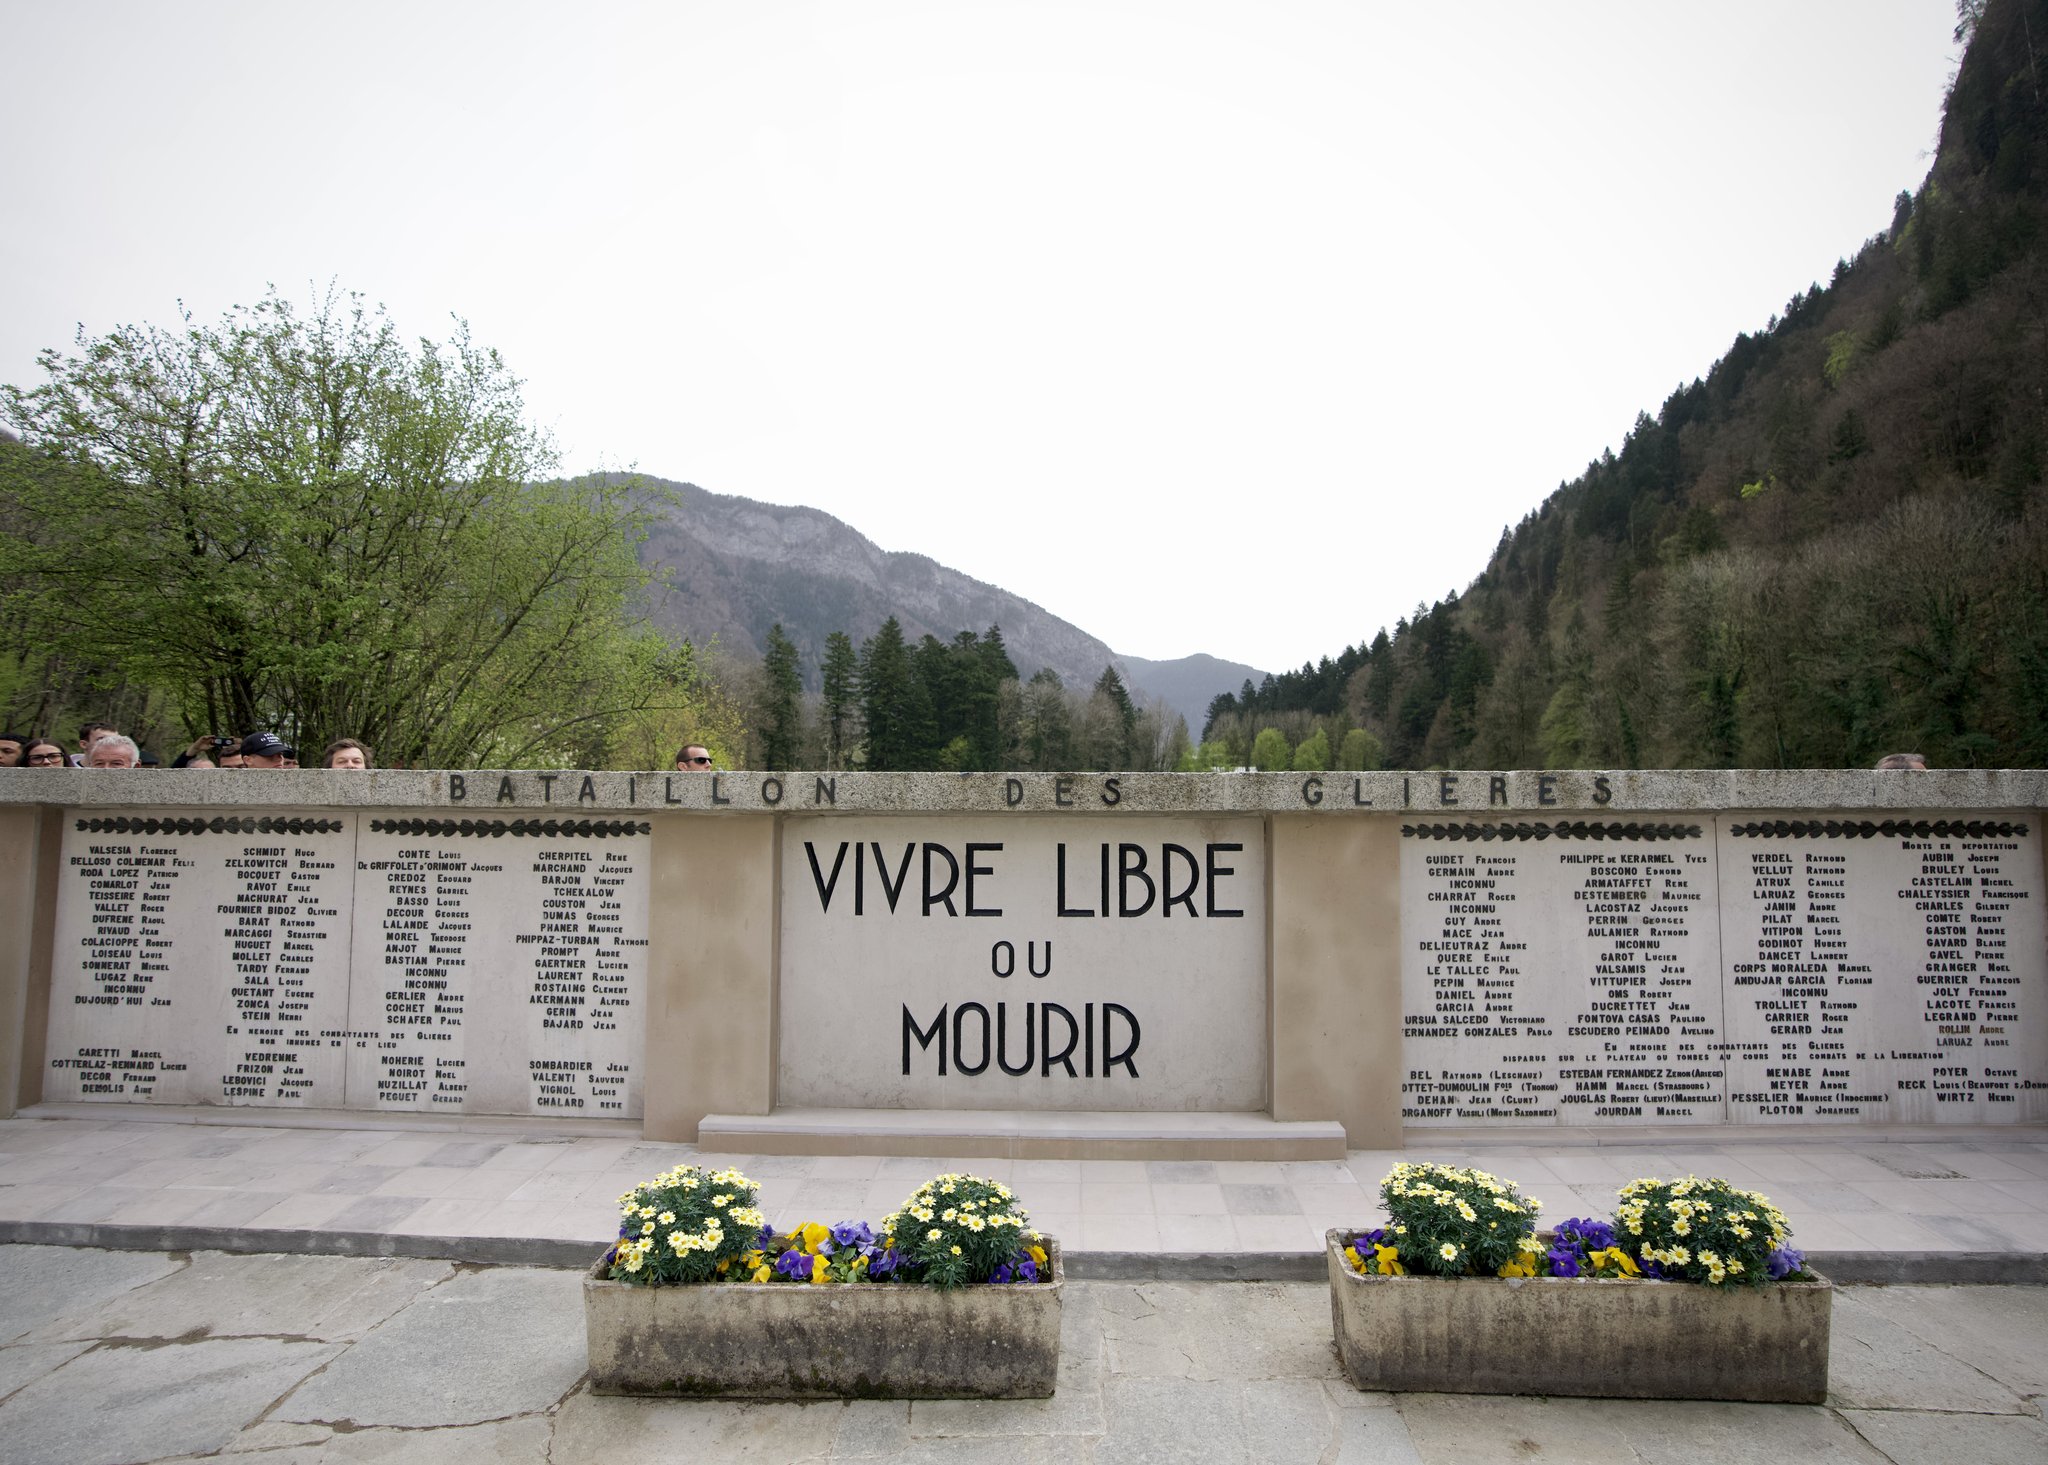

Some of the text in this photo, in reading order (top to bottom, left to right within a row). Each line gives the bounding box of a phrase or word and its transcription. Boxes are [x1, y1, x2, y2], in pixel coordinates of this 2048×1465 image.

[450, 774, 1612, 806] BATAILLON DES GLIERES
[89, 845, 131, 854] VALSESIA
[243, 847, 286, 856] SCHMIDT
[398, 850, 430, 859] CONTE
[539, 851, 592, 861] CHERPITEL
[1560, 854, 1674, 864] PHILIPPE KERARMEL
[1752, 854, 1792, 863] VERDEL
[1922, 853, 1954, 862] AUBIN
[225, 858, 288, 868] ZELKOWITCH
[1426, 855, 1464, 864] GUIDET
[80, 868, 139, 878] RODA LOPEZ
[533, 864, 586, 873] MARCHAND
[1429, 868, 1475, 877] GERMAIN
[1752, 866, 1793, 875] VELLUT
[1922, 865, 1964, 874] BRULEY
[237, 870, 281, 880] BOCQUET
[387, 873, 426, 882] CREDOZ
[804, 842, 1243, 917] VIVRE LIBRE
[542, 875, 580, 885] BARJON
[1585, 879, 1651, 888] ARMATAFFET
[1756, 878, 1790, 887] ATRUX
[247, 882, 277, 891] RAVOT
[389, 885, 426, 894] REYNES
[554, 887, 614, 897] TCHEKALOW
[1428, 892, 1476, 901] CHARRAT
[1753, 890, 1795, 899] LARUAZ
[1898, 889, 1970, 898] CHALEYSSIER
[237, 894, 288, 903] MACHURAT
[397, 897, 429, 906] BASSO
[95, 903, 129, 912] VALLET
[543, 899, 585, 908] COUSTON
[1586, 903, 1640, 912] LACOSTAZ
[1916, 901, 1963, 910] CHARLES
[387, 908, 424, 917] DECOUR
[543, 911, 576, 920] DUMAS
[239, 917, 270, 926] BARAT
[1445, 917, 1466, 926] GUY
[1589, 916, 1629, 925] PERRIN
[1762, 914, 1792, 924] PILAT
[383, 920, 428, 929] LALANDE
[540, 923, 579, 932] PHANER
[97, 926, 130, 935] RIVAUD
[1443, 929, 1472, 938] MACE
[1588, 928, 1639, 937] AULANIER
[1926, 926, 1966, 935] GASTON
[386, 932, 419, 941] MOREL
[235, 940, 271, 950] HUGUET
[1420, 941, 1489, 951] DELIEUTRAZ
[1927, 938, 1967, 947] GAVARD
[386, 944, 417, 953] ANJOT
[541, 947, 579, 956] PROMPT
[92, 949, 132, 958] LOISEAU
[1601, 952, 1635, 962] GAROT
[1930, 950, 1963, 959] GAVEL
[385, 956, 427, 965] BASTIAN
[992, 941, 1051, 978] OU
[1437, 953, 1472, 964] QUERE
[535, 959, 586, 968] GAERTNER
[1734, 963, 1828, 973] CORPS MORALEDA
[1926, 963, 1977, 972] GRANGER
[237, 964, 268, 973] TARDY
[1595, 965, 1646, 974] VALSAMIS
[95, 972, 126, 982] LUGAZ
[244, 976, 269, 985] SALA
[538, 971, 583, 981] LAURENT
[1917, 975, 1968, 984] GUERRIER
[1434, 978, 1464, 988] PEPIN
[1590, 977, 1646, 986] VITTUPIER
[1734, 976, 1825, 986] ANDUJAR GARCIA
[535, 983, 585, 994] ROSTAING
[1933, 988, 1960, 997] JOLY
[386, 992, 425, 1001] GERLIER
[1436, 991, 1475, 1000] DANIEL
[1608, 989, 1629, 998] OMS
[530, 994, 585, 1005] AKERMANN
[386, 1004, 425, 1013] COCHET
[1436, 1003, 1474, 1012] GARCIA
[1592, 1001, 1656, 1011] DUCRETTET
[1754, 1000, 1807, 1010] TROLLIET
[1927, 1000, 1971, 1009] LACOTE
[546, 1007, 576, 1018] GERIN
[1924, 1012, 1976, 1022] LEGRAND
[387, 1015, 432, 1025] SCHAFER
[1405, 1015, 1488, 1025] URSUA SALCEDO
[1578, 1014, 1660, 1024] FONTOVA CASAS
[1765, 1013, 1809, 1022] CARRIER
[543, 1018, 583, 1029] BAJARD
[1464, 1027, 1517, 1038] GONZALES
[1568, 1026, 1670, 1036] ESCUDERO PEINADO
[1771, 1025, 1812, 1035] GERARD
[902, 1002, 1140, 1078] MOURIR
[1937, 1038, 1972, 1047] LARUAZ
[78, 1048, 120, 1058] CARETTI
[237, 1064, 273, 1074] FRIZON
[529, 1061, 592, 1071] SOMBARDIER
[1410, 1071, 1432, 1080] BEL
[1607, 1069, 1663, 1078] FERNANDEZ
[1933, 1067, 1968, 1076] POYER
[80, 1072, 111, 1081] DECOR
[223, 1076, 266, 1086] LEBOVICI
[532, 1072, 575, 1083] VALENTI
[1576, 1082, 1607, 1091] HAMM
[1771, 1080, 1808, 1090] MEYER
[1898, 1080, 1926, 1090] RECK
[540, 1085, 576, 1095] VIGNOL
[1560, 1094, 1606, 1104] JOUGLAS
[1731, 1093, 1788, 1103] PESSELIER
[1937, 1093, 1974, 1102] WIRTZ
[1595, 1107, 1642, 1117] JOURDAN
[1760, 1105, 1803, 1115] PLOTON
